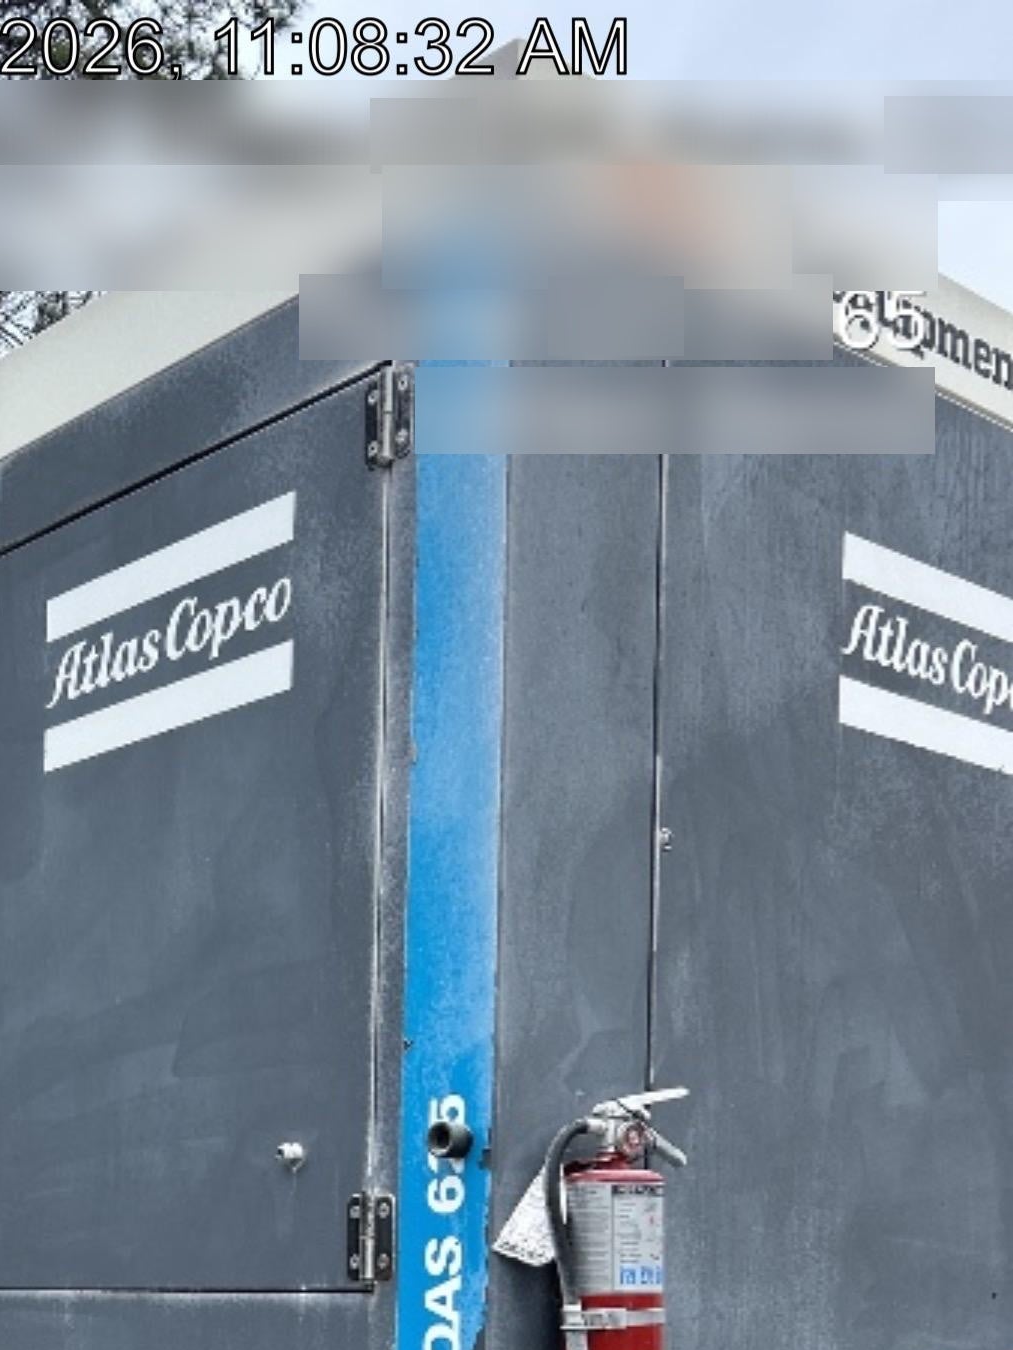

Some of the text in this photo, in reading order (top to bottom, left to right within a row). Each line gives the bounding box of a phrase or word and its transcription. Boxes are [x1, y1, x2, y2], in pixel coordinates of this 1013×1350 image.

[45, 577, 291, 708] Atlas Copco
[842, 604, 1013, 714] Atlas Cop
